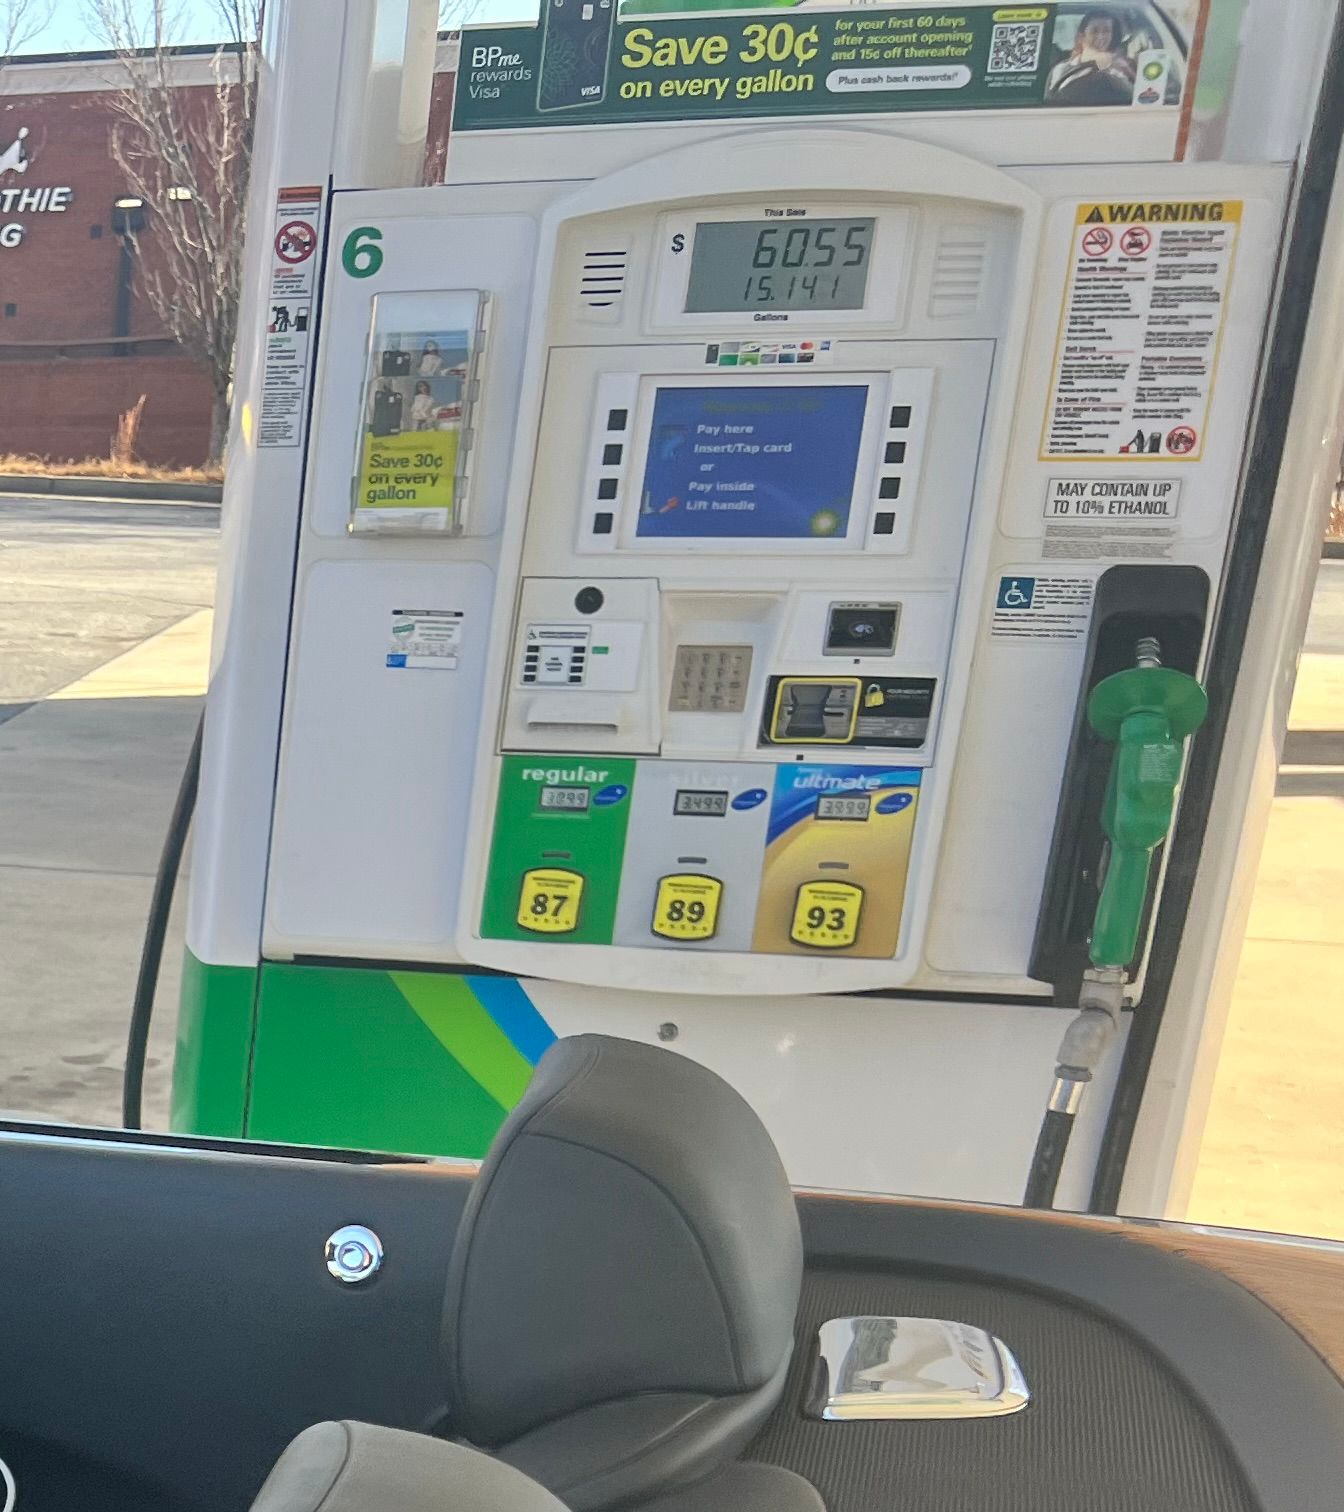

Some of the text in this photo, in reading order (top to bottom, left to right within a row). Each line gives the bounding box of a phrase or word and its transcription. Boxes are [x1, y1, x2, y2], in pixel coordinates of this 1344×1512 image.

[835, 16, 966, 32] for your first 60 days
[621, 22, 820, 68] Save 30¢
[833, 31, 973, 46] after account opening
[472, 46, 523, 68] BPme
[831, 49, 856, 61] and
[883, 47, 902, 58] off
[471, 66, 532, 82] rewards
[838, 76, 858, 85] Plus
[861, 76, 883, 84] cash
[886, 75, 909, 83] back
[469, 85, 500, 99] Visa
[581, 85, 601, 97] VISA
[619, 69, 815, 100] on every gallon
[1108, 203, 1224, 222] WARNING
[671, 233, 685, 254] $
[342, 226, 383, 279] 6
[753, 313, 788, 322] Gallons
[697, 424, 754, 436] Pay here
[694, 442, 792, 454] Insert/Tap card
[370, 453, 443, 469] Save 30¢
[700, 464, 715, 472] or
[368, 473, 439, 487] on every
[688, 482, 713, 493] Pay
[366, 485, 416, 503] gallon
[1056, 482, 1172, 497] MAY CONTAIN UP
[686, 501, 755, 511] Lift handle
[1053, 500, 1169, 515] TO 10% ETHANOL
[522, 766, 609, 784] regular
[530, 893, 569, 917] 87
[667, 900, 705, 923] 89
[806, 906, 846, 931] 93
